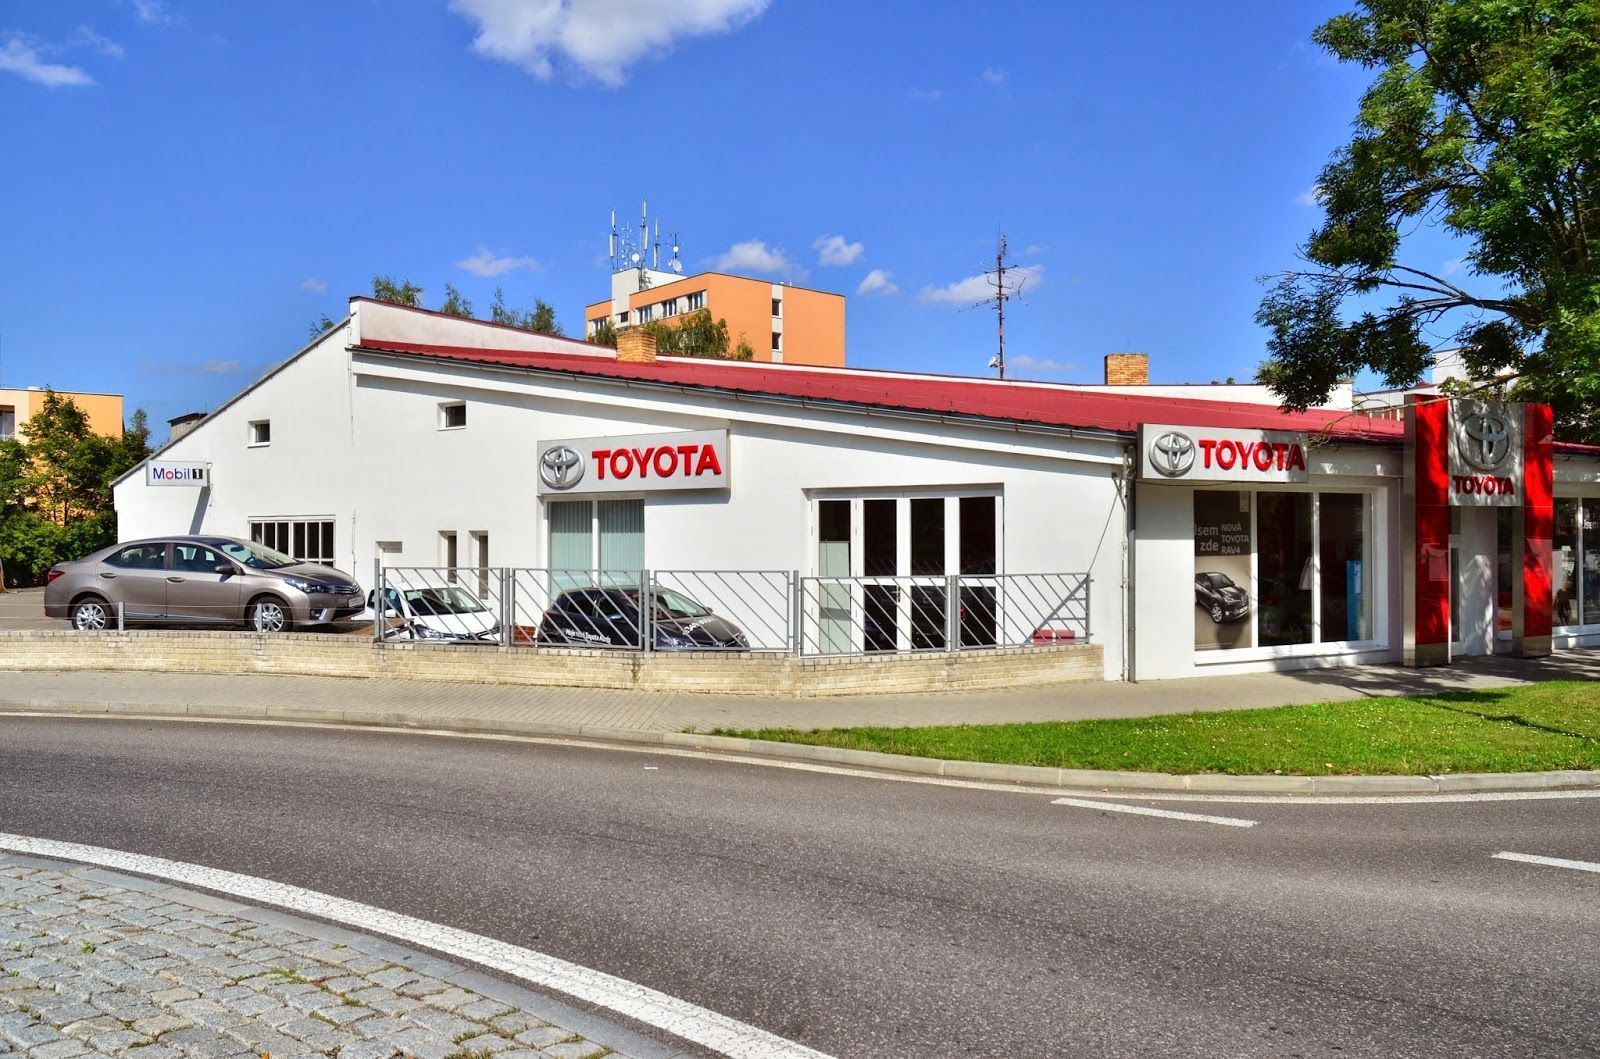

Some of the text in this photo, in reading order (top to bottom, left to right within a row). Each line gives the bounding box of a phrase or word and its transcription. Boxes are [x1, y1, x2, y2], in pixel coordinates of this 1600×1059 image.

[591, 444, 722, 480] TOYOTA
[1198, 439, 1306, 472] TOYOTA
[153, 467, 190, 480] Mobil
[1453, 475, 1515, 496] TOYOTA
[1199, 538, 1219, 552] zde
[1221, 534, 1250, 544] TOYOTA
[1221, 545, 1241, 555] RAV4
